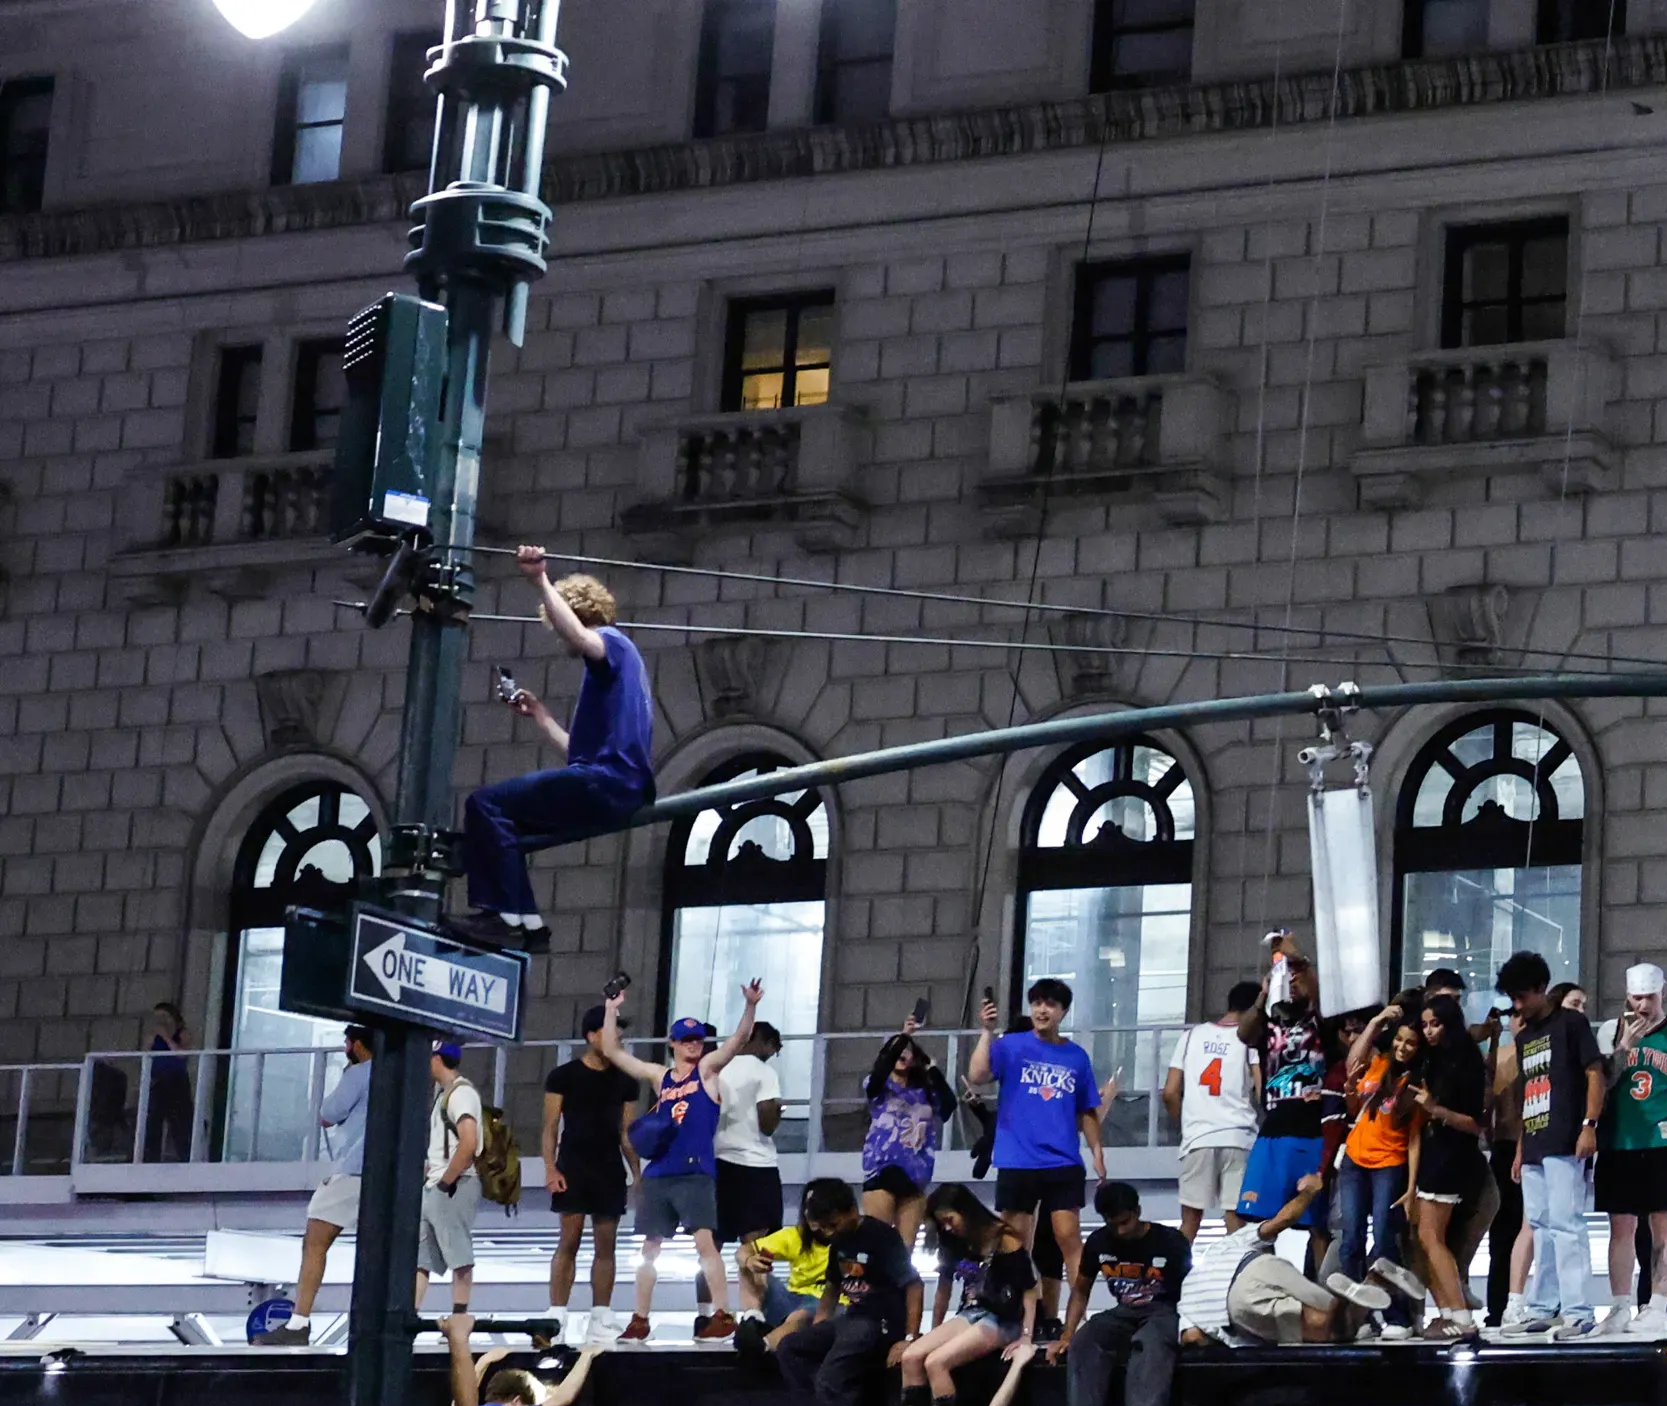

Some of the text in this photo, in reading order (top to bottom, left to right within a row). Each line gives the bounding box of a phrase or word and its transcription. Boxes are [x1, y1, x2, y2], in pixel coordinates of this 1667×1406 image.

[382, 949, 496, 1005] ONE WAY
[1203, 1040, 1231, 1056] ROSE
[1020, 1066, 1077, 1094] KNICKS
[1199, 1057, 1222, 1096] 4
[1629, 1070, 1653, 1101] 3
